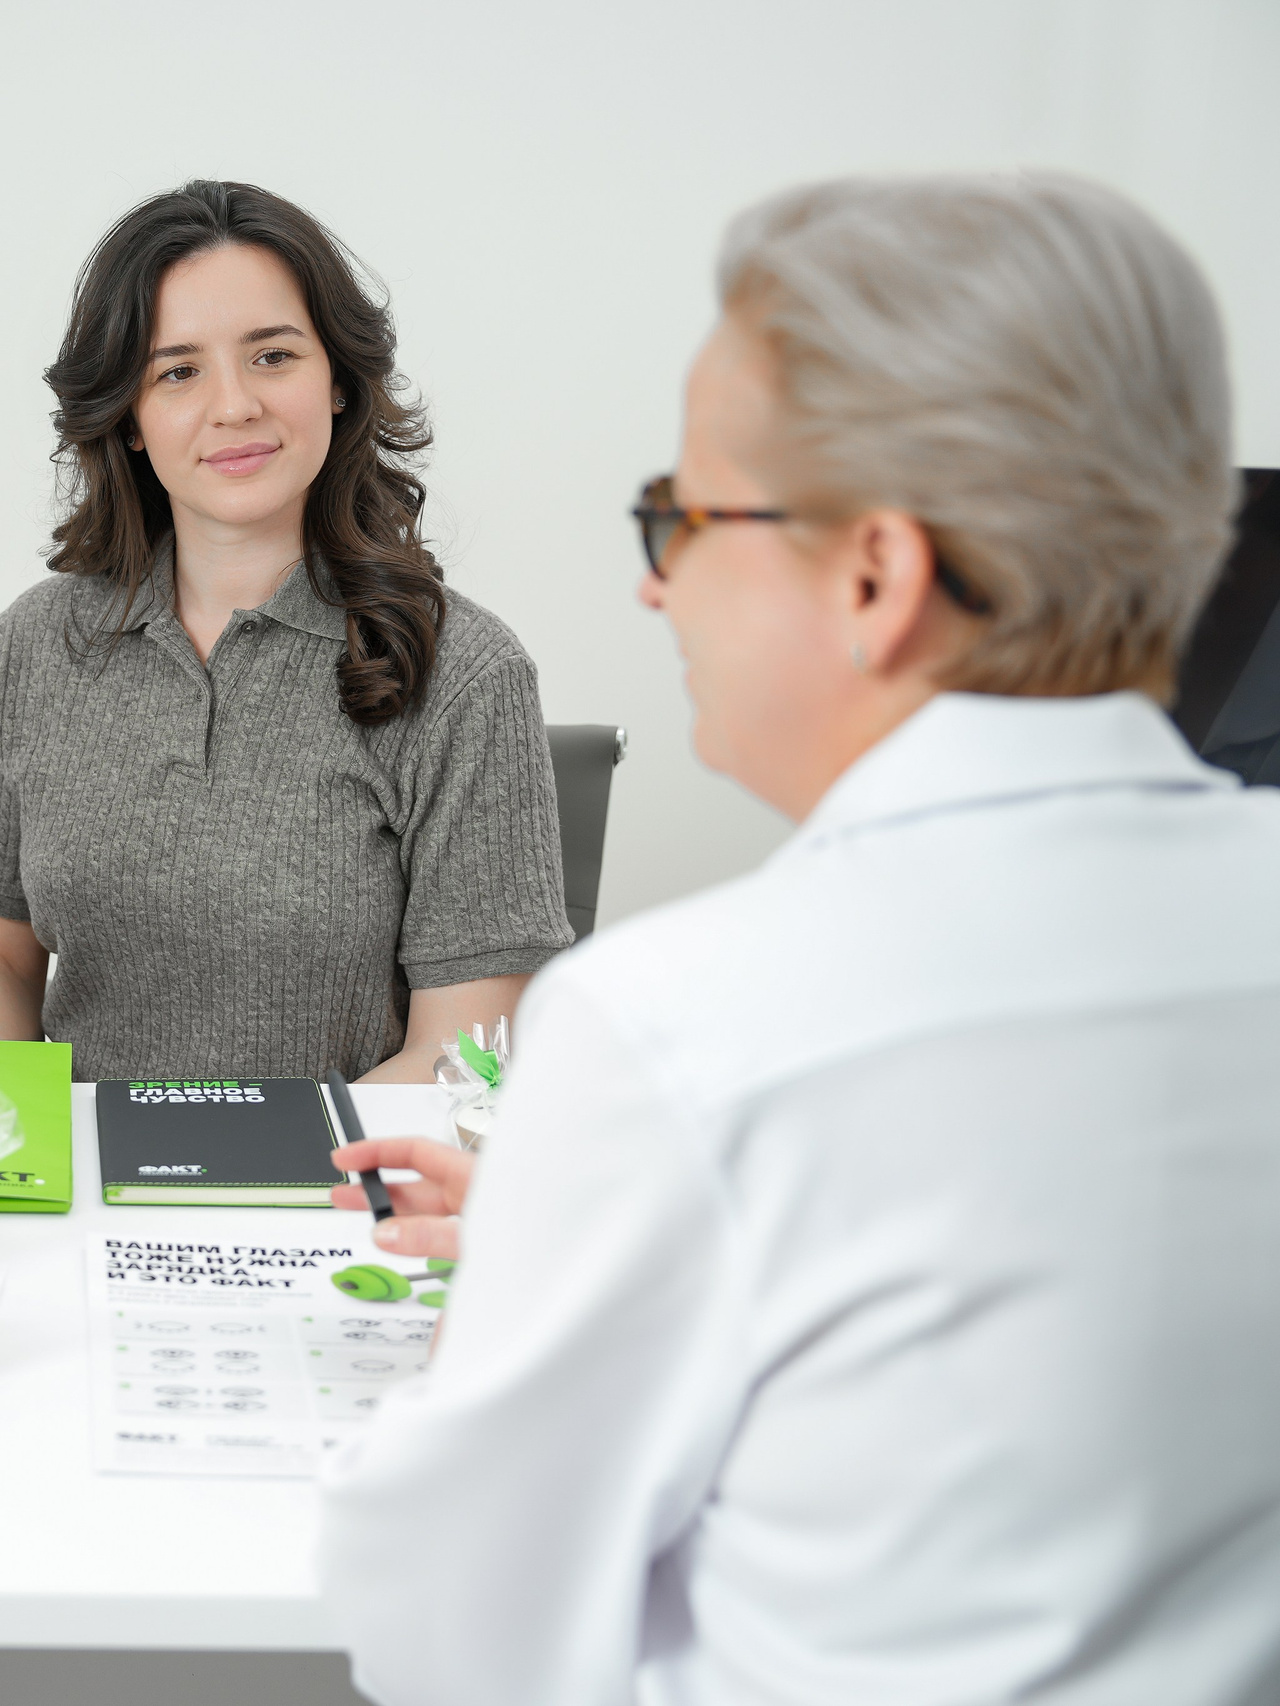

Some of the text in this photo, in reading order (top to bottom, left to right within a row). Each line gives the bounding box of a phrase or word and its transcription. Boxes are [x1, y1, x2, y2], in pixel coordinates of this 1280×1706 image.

[128, 1081, 240, 1089] ЗРЕНИЕ
[129, 1087, 262, 1096] ГЛАВНОЕ
[129, 1095, 266, 1104] ЧУВСТВО
[106, 1239, 352, 1257] ВАШИМ ГЛАЗАМ
[106, 1249, 319, 1268] ТОЖЕ НУЖНА
[106, 1260, 260, 1277] ЗАРЯДКА.
[107, 1271, 296, 1288] И ЭТО ФАКТ
